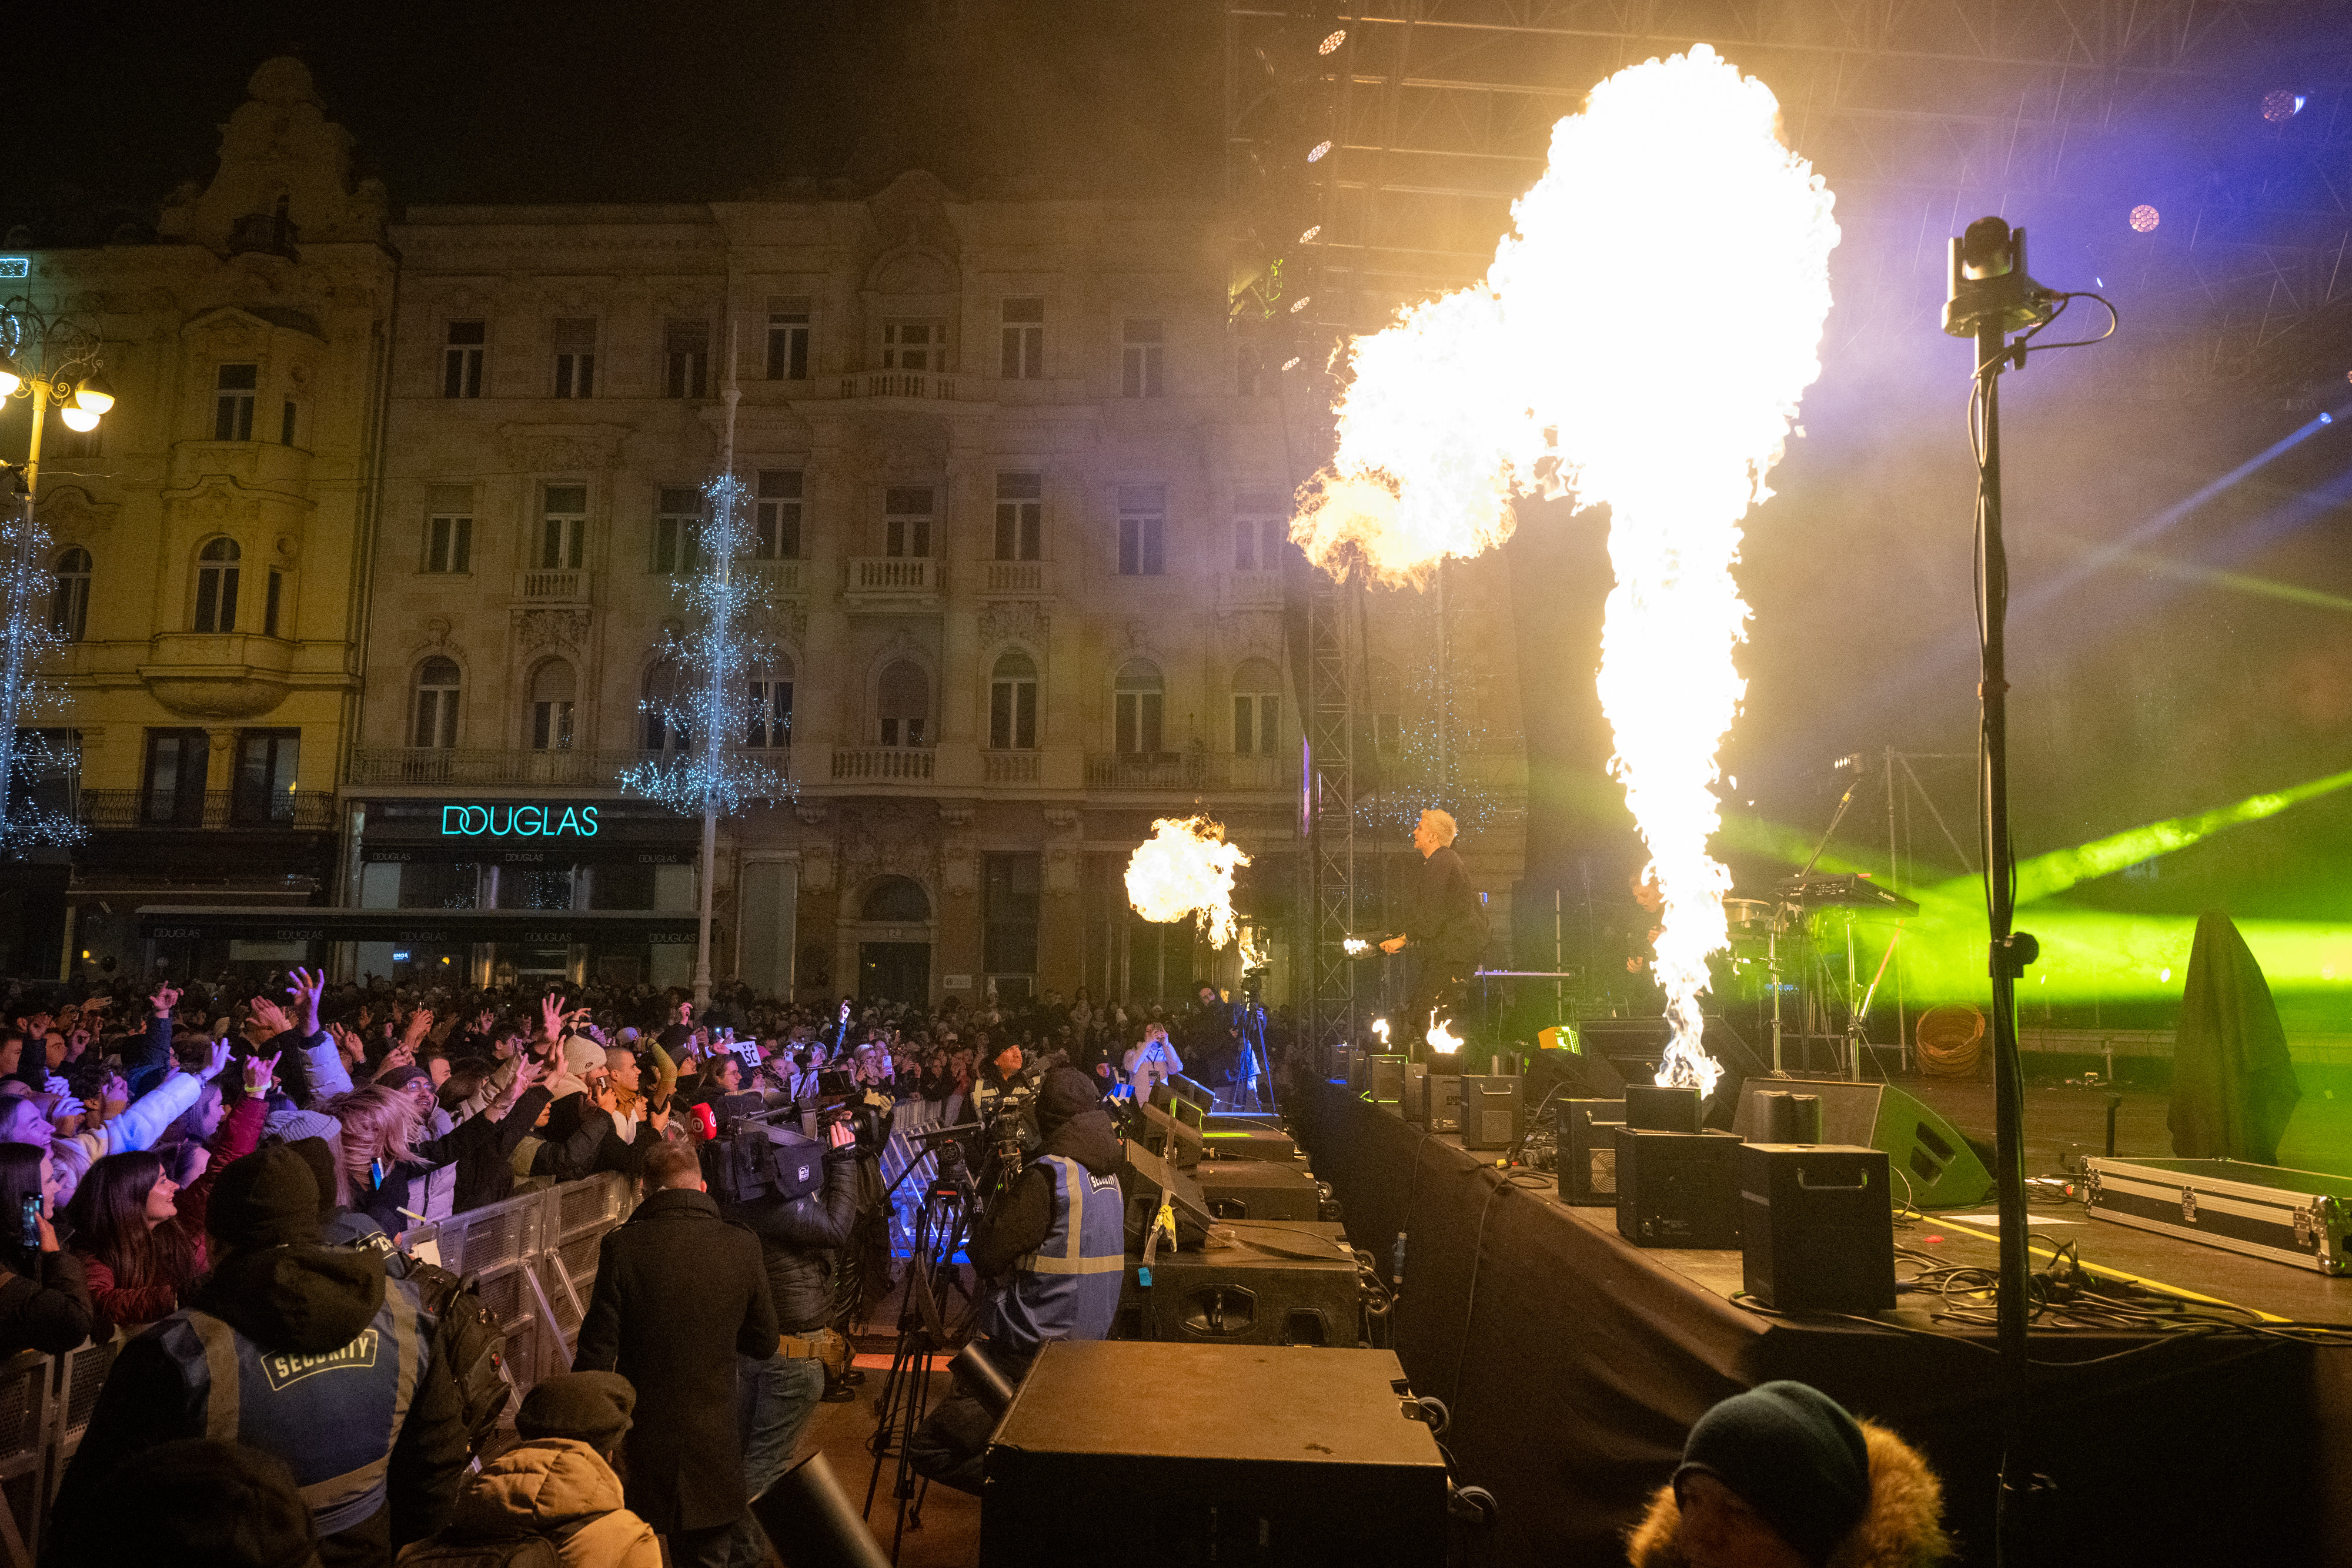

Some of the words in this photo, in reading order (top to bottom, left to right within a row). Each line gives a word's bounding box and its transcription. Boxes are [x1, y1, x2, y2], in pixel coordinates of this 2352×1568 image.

[442, 805, 598, 836] DOUGLAS
[373, 852, 410, 861] DOUGLAS
[505, 853, 543, 862] DOUGLAS
[638, 854, 677, 862] DOUGLAS
[1877, 891, 1895, 902] ALESIS
[153, 928, 201, 938] DOUGLAS
[277, 930, 323, 940] DOUGLAS
[400, 931, 447, 941] DOUGLAS
[524, 932, 572, 942] DOUGLAS
[649, 933, 695, 942] DOUGLAS
